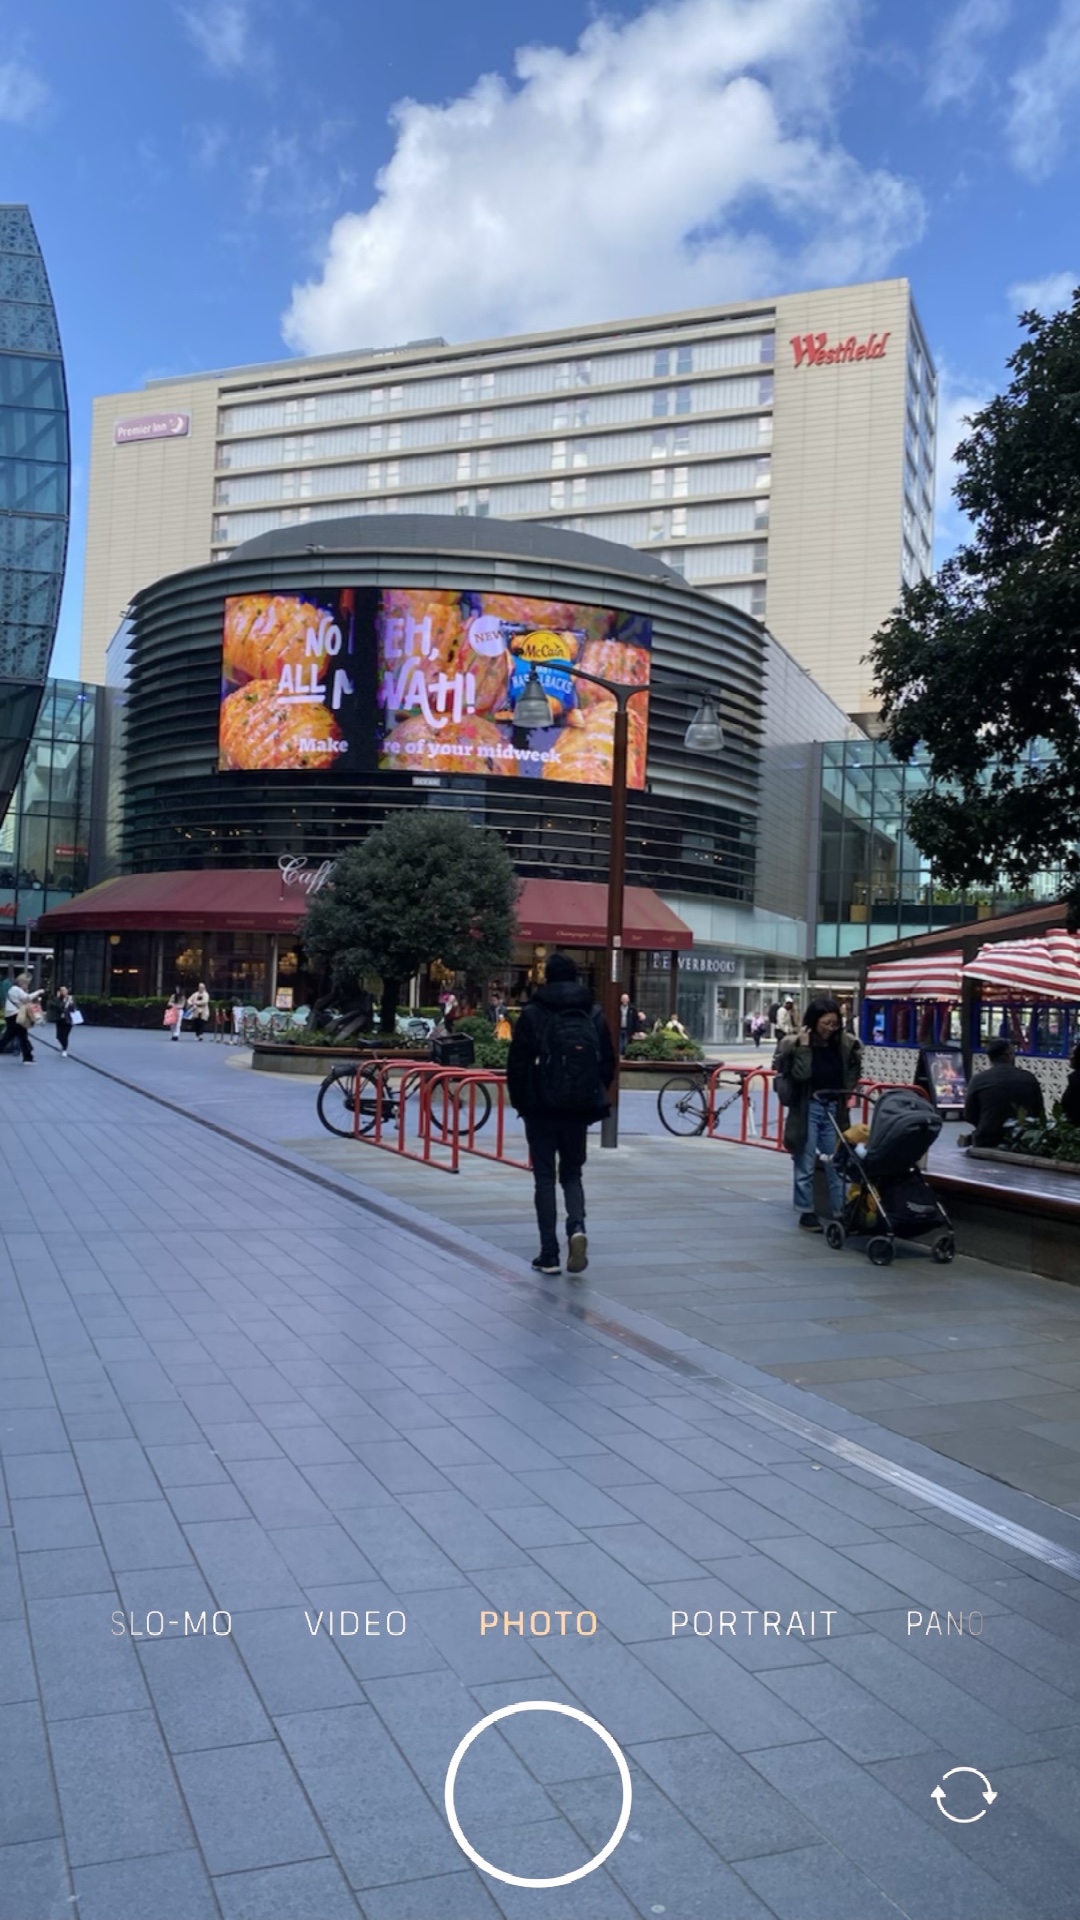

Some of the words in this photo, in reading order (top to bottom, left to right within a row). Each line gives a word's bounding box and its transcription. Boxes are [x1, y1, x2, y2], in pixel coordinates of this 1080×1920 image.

[789, 332, 891, 369] Westfield
[117, 424, 151, 437] Premier
[152, 422, 168, 433] Inn
[304, 616, 342, 657] NO
[474, 630, 507, 644] NEW
[524, 644, 565, 658] McCain
[276, 663, 327, 694] ALL
[299, 738, 349, 753] Make
[405, 739, 424, 754] of
[427, 741, 473, 758] your
[477, 741, 561, 763] midweek
[277, 854, 338, 894] Caff
[653, 952, 736, 973] BEVERBROOKS
